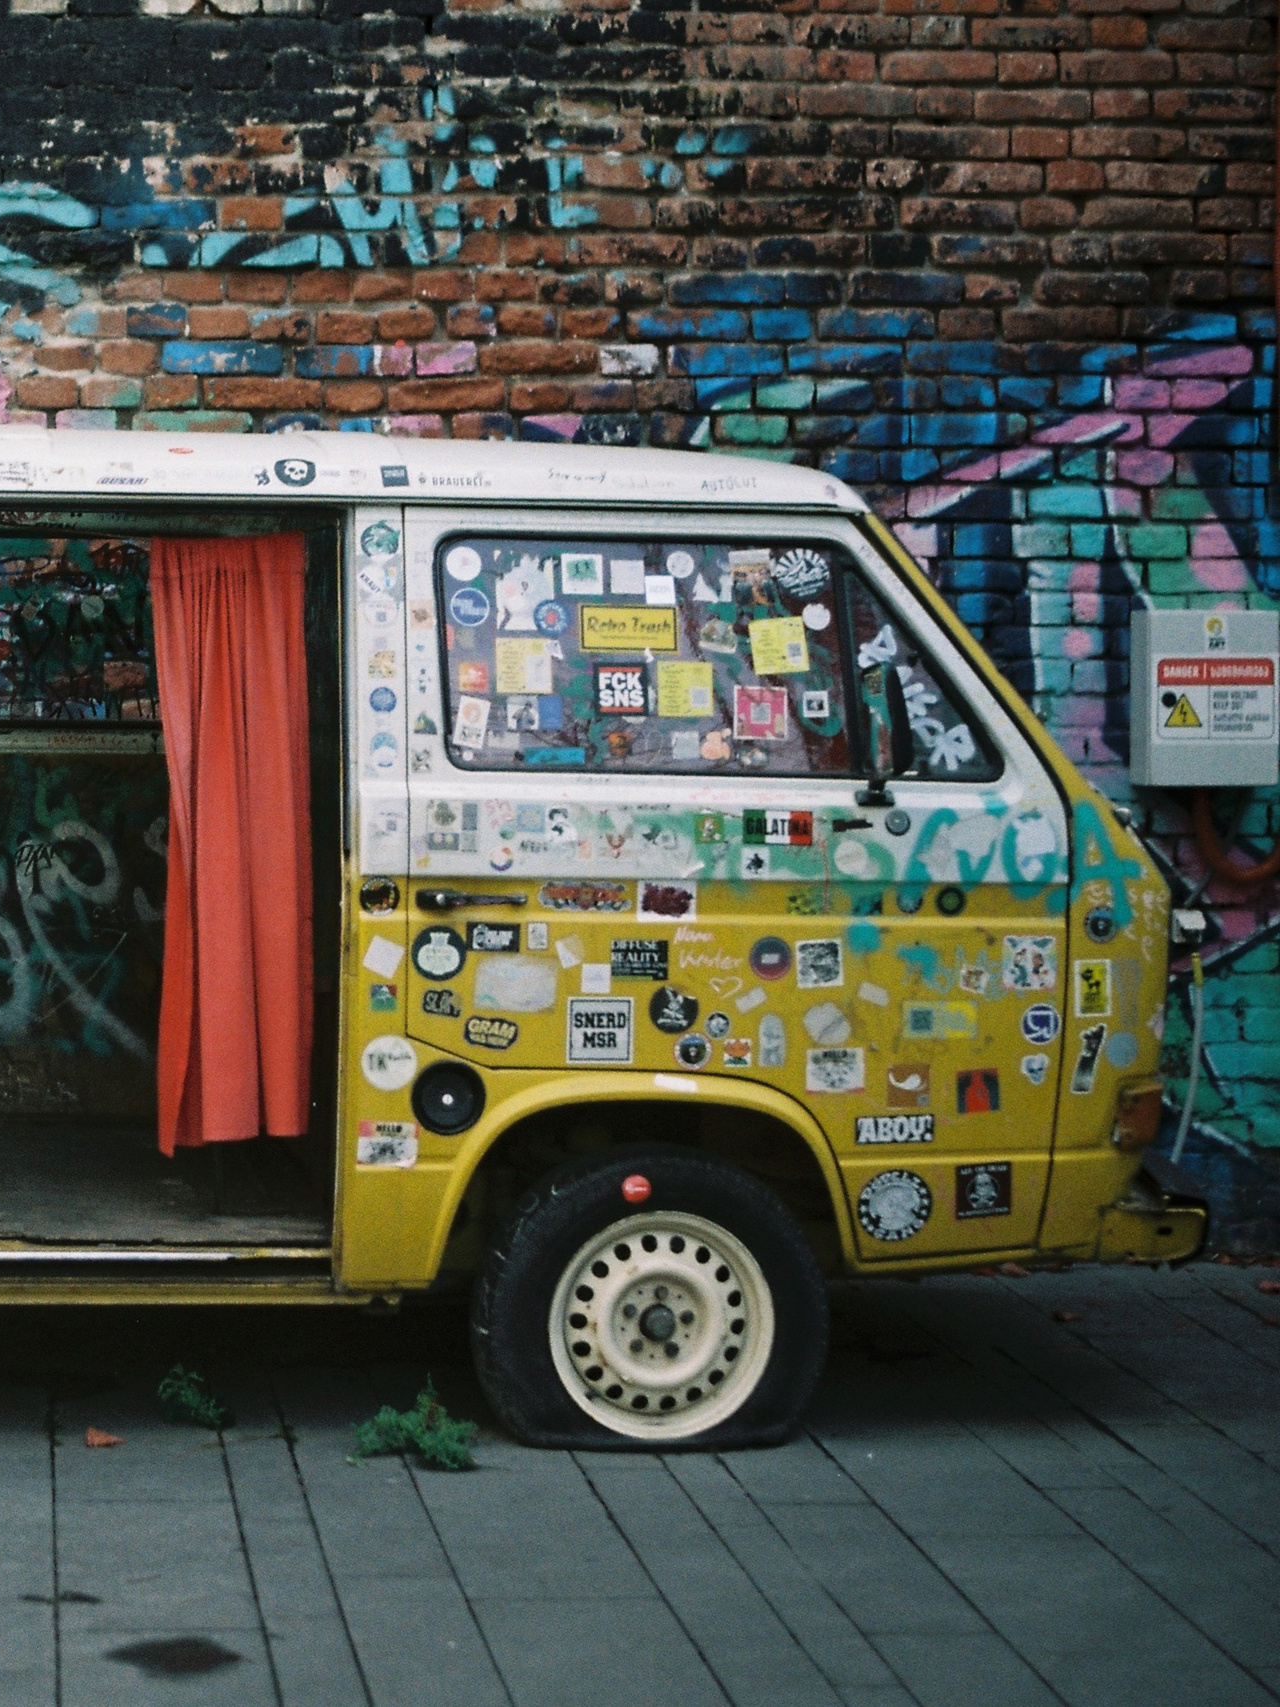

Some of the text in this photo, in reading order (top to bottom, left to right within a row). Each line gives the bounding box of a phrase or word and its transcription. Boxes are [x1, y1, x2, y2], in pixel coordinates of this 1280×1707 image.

[631, 616, 671, 633] Trash
[1163, 665, 1199, 678] DANGER
[598, 671, 643, 690] FCK
[599, 689, 645, 708] SNS
[611, 940, 659, 950] DIFFUSE
[467, 1018, 517, 1039] GRAM
[573, 1012, 628, 1029] SNERD
[583, 1032, 618, 1049] MSR
[375, 1123, 403, 1135] HELLO
